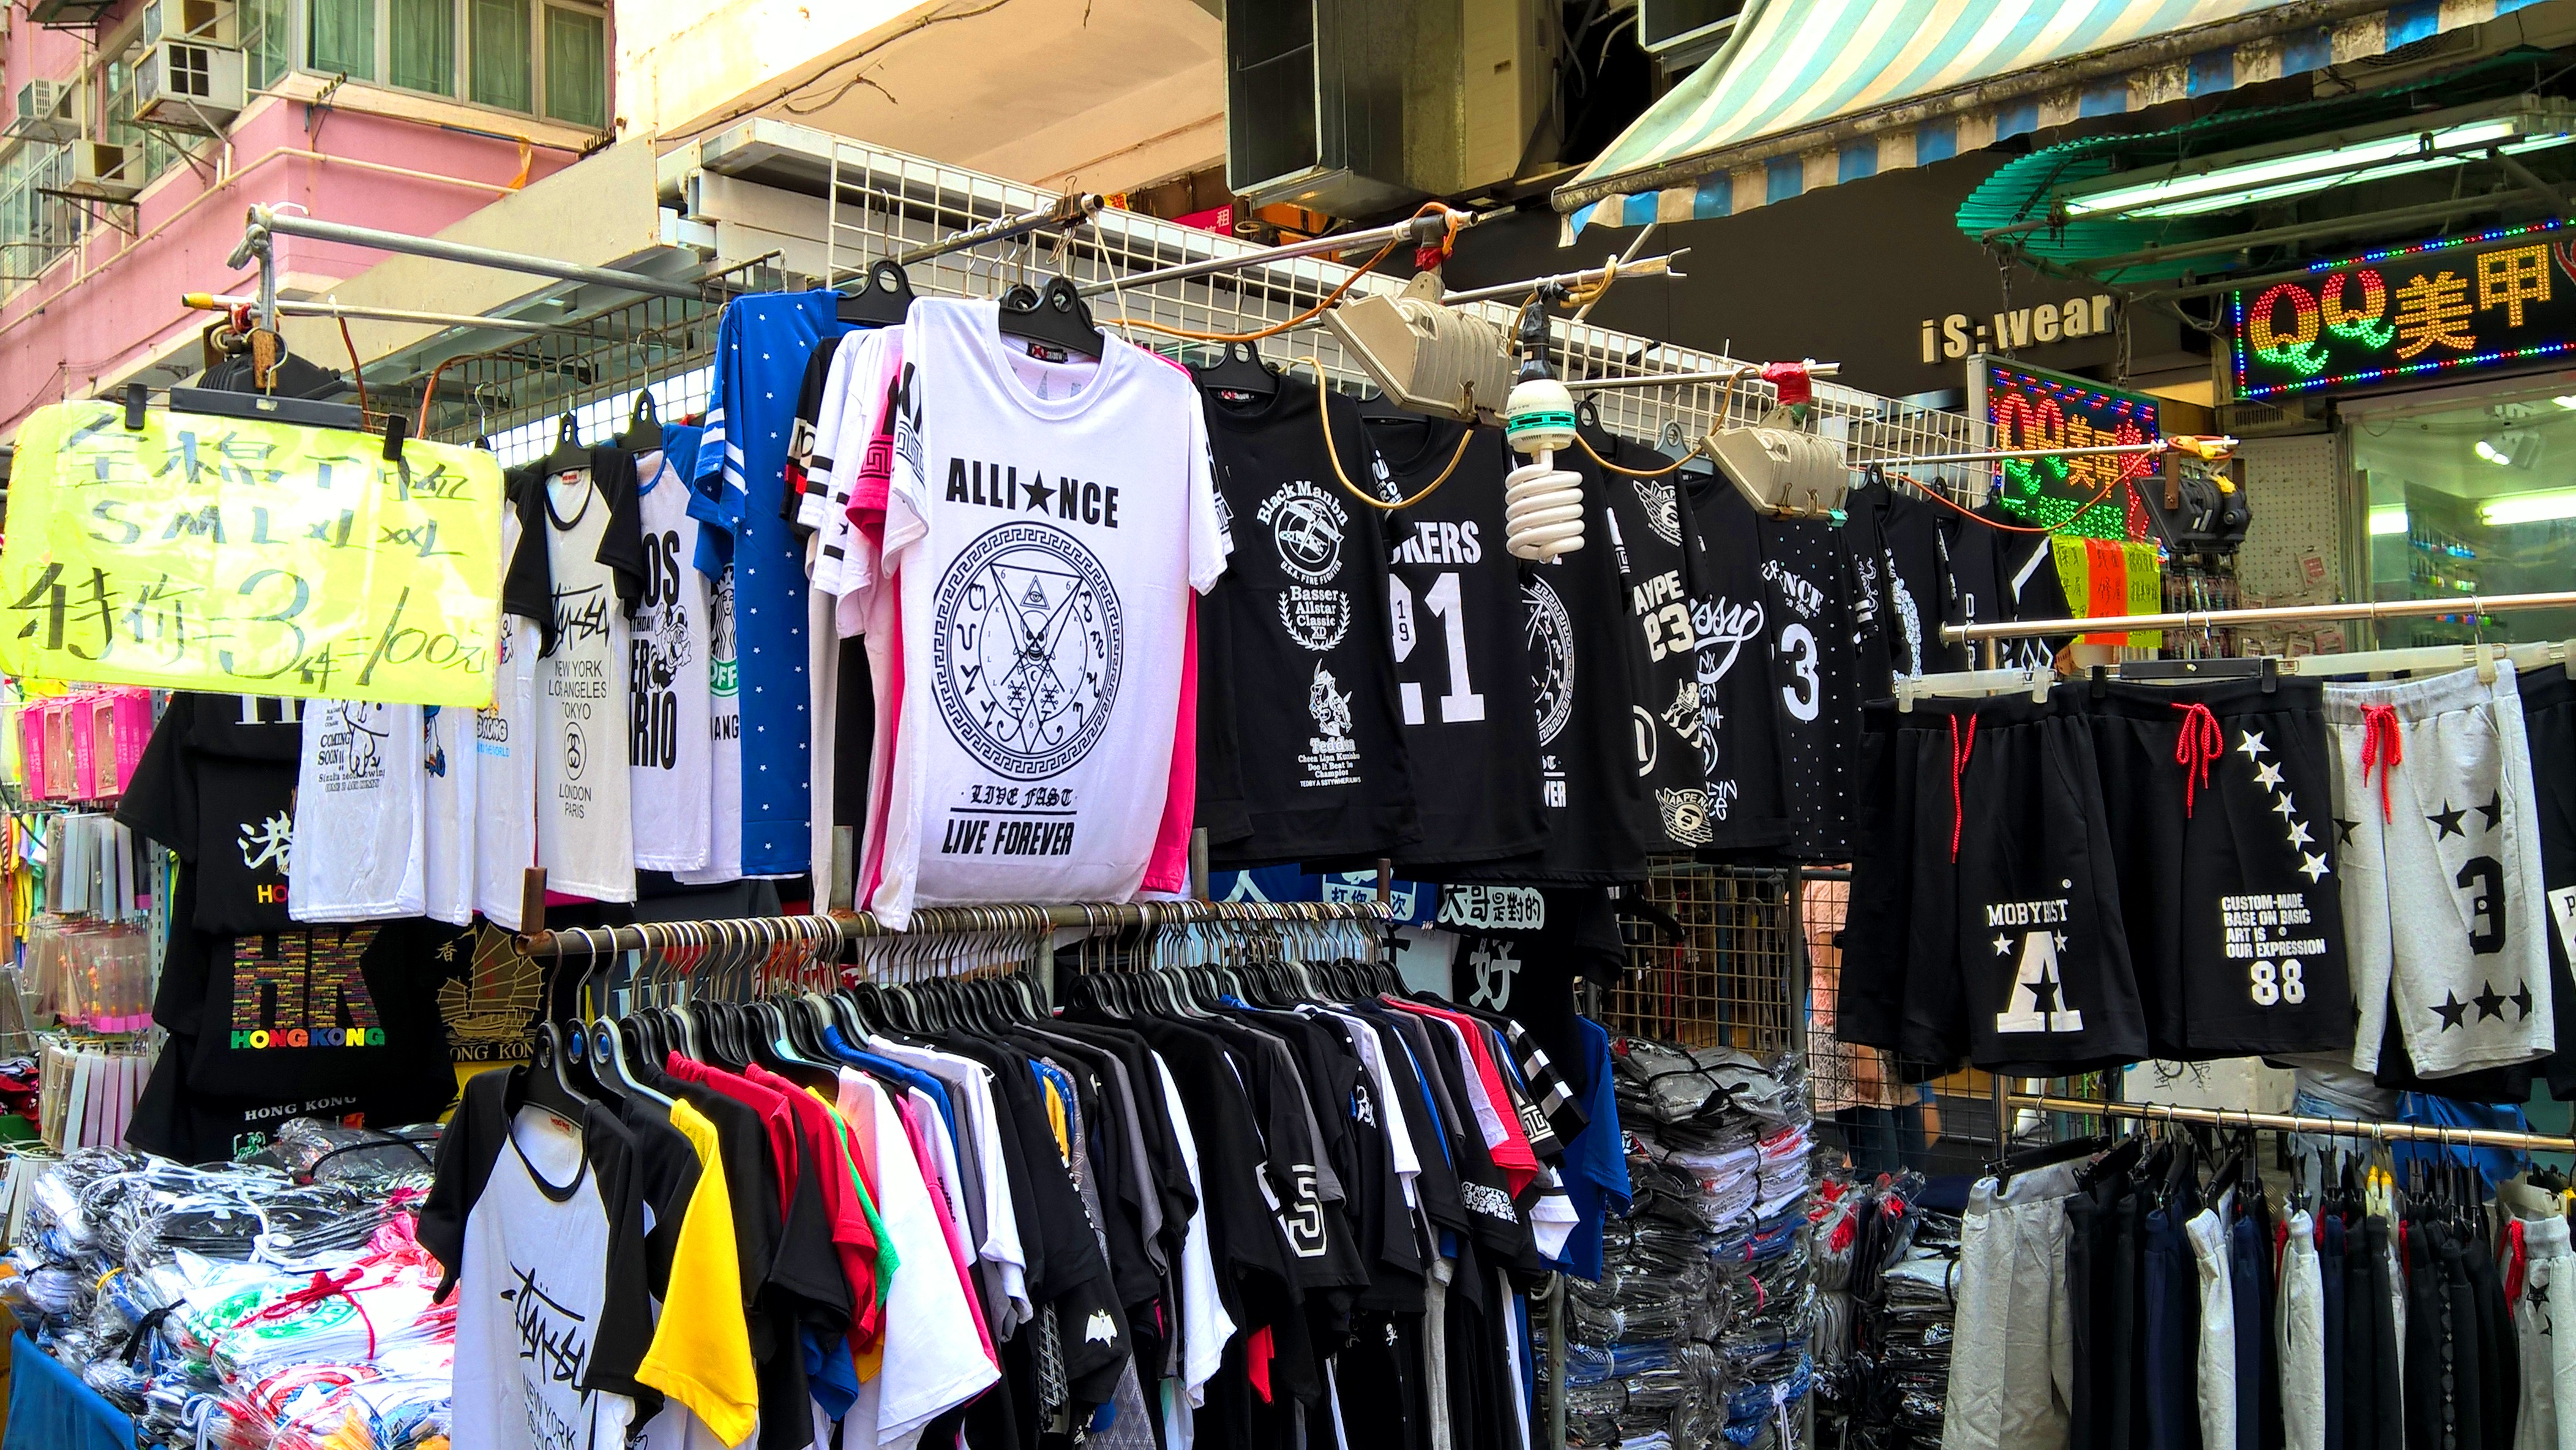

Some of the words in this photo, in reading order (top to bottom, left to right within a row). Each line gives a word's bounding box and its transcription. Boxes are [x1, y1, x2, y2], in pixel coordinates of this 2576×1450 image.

[945, 457, 1120, 530] ALLINCE
[88, 500, 141, 544] S
[162, 505, 226, 544] M
[251, 506, 290, 545] L
[1300, 574, 1319, 586] FIRE
[1289, 585, 1339, 601] Basser
[1295, 601, 1337, 615] Allstar
[1296, 614, 1336, 627] Classic
[573, 659, 603, 678] YORK
[1781, 623, 1820, 722] 3
[563, 680, 607, 699] ANGELES
[559, 783, 592, 803] LONDON
[564, 802, 585, 819] PARIS
[941, 819, 990, 855] LIVE
[992, 821, 1075, 857] FOREVER
[1332, 888, 1407, 916] 打你次
[1441, 885, 1541, 923] 大哥是對的
[2221, 893, 2304, 912] CUSTOM-MADE
[2455, 855, 2507, 955] 3
[2223, 911, 2258, 927] BASE
[2258, 910, 2278, 925] ON
[2280, 909, 2312, 925] BASIC
[2225, 927, 2252, 943] ART
[2253, 926, 2267, 942] IS
[2225, 943, 2254, 959] OUR
[2255, 938, 2326, 958] EXPRESSION
[1469, 937, 1521, 1012] 好
[2250, 958, 2306, 1006] 88
[245, 1103, 297, 1121] HONG
